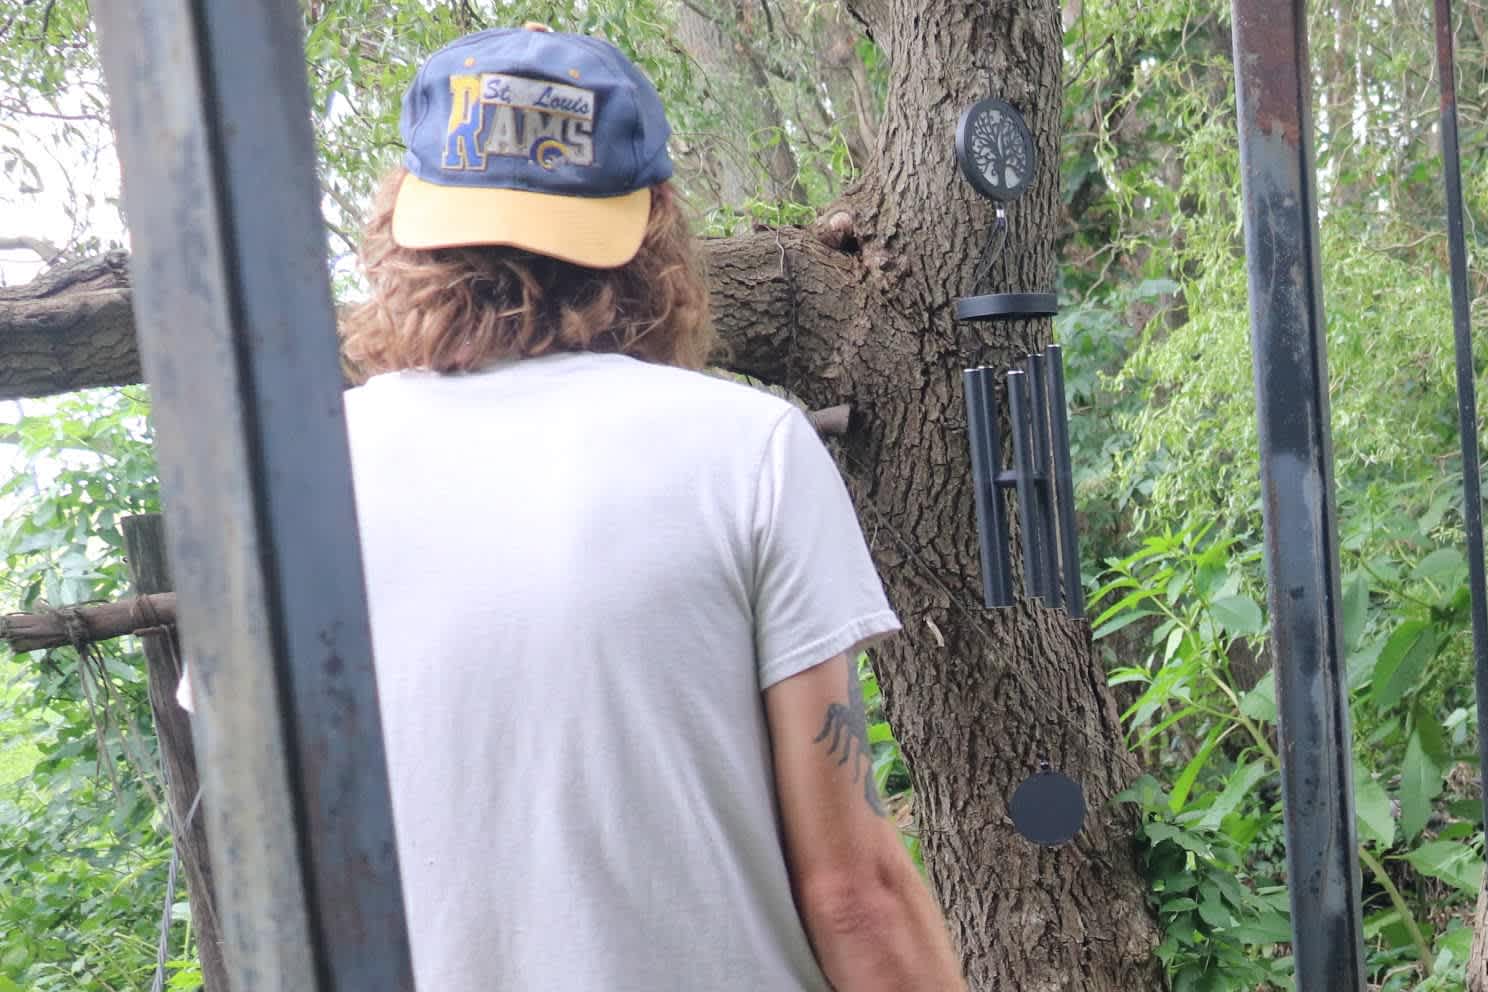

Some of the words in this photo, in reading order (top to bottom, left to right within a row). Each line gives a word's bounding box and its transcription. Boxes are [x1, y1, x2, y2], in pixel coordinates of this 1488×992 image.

[441, 73, 595, 172] RAMS
[483, 78, 513, 105] St.
[532, 86, 591, 115] Louis
